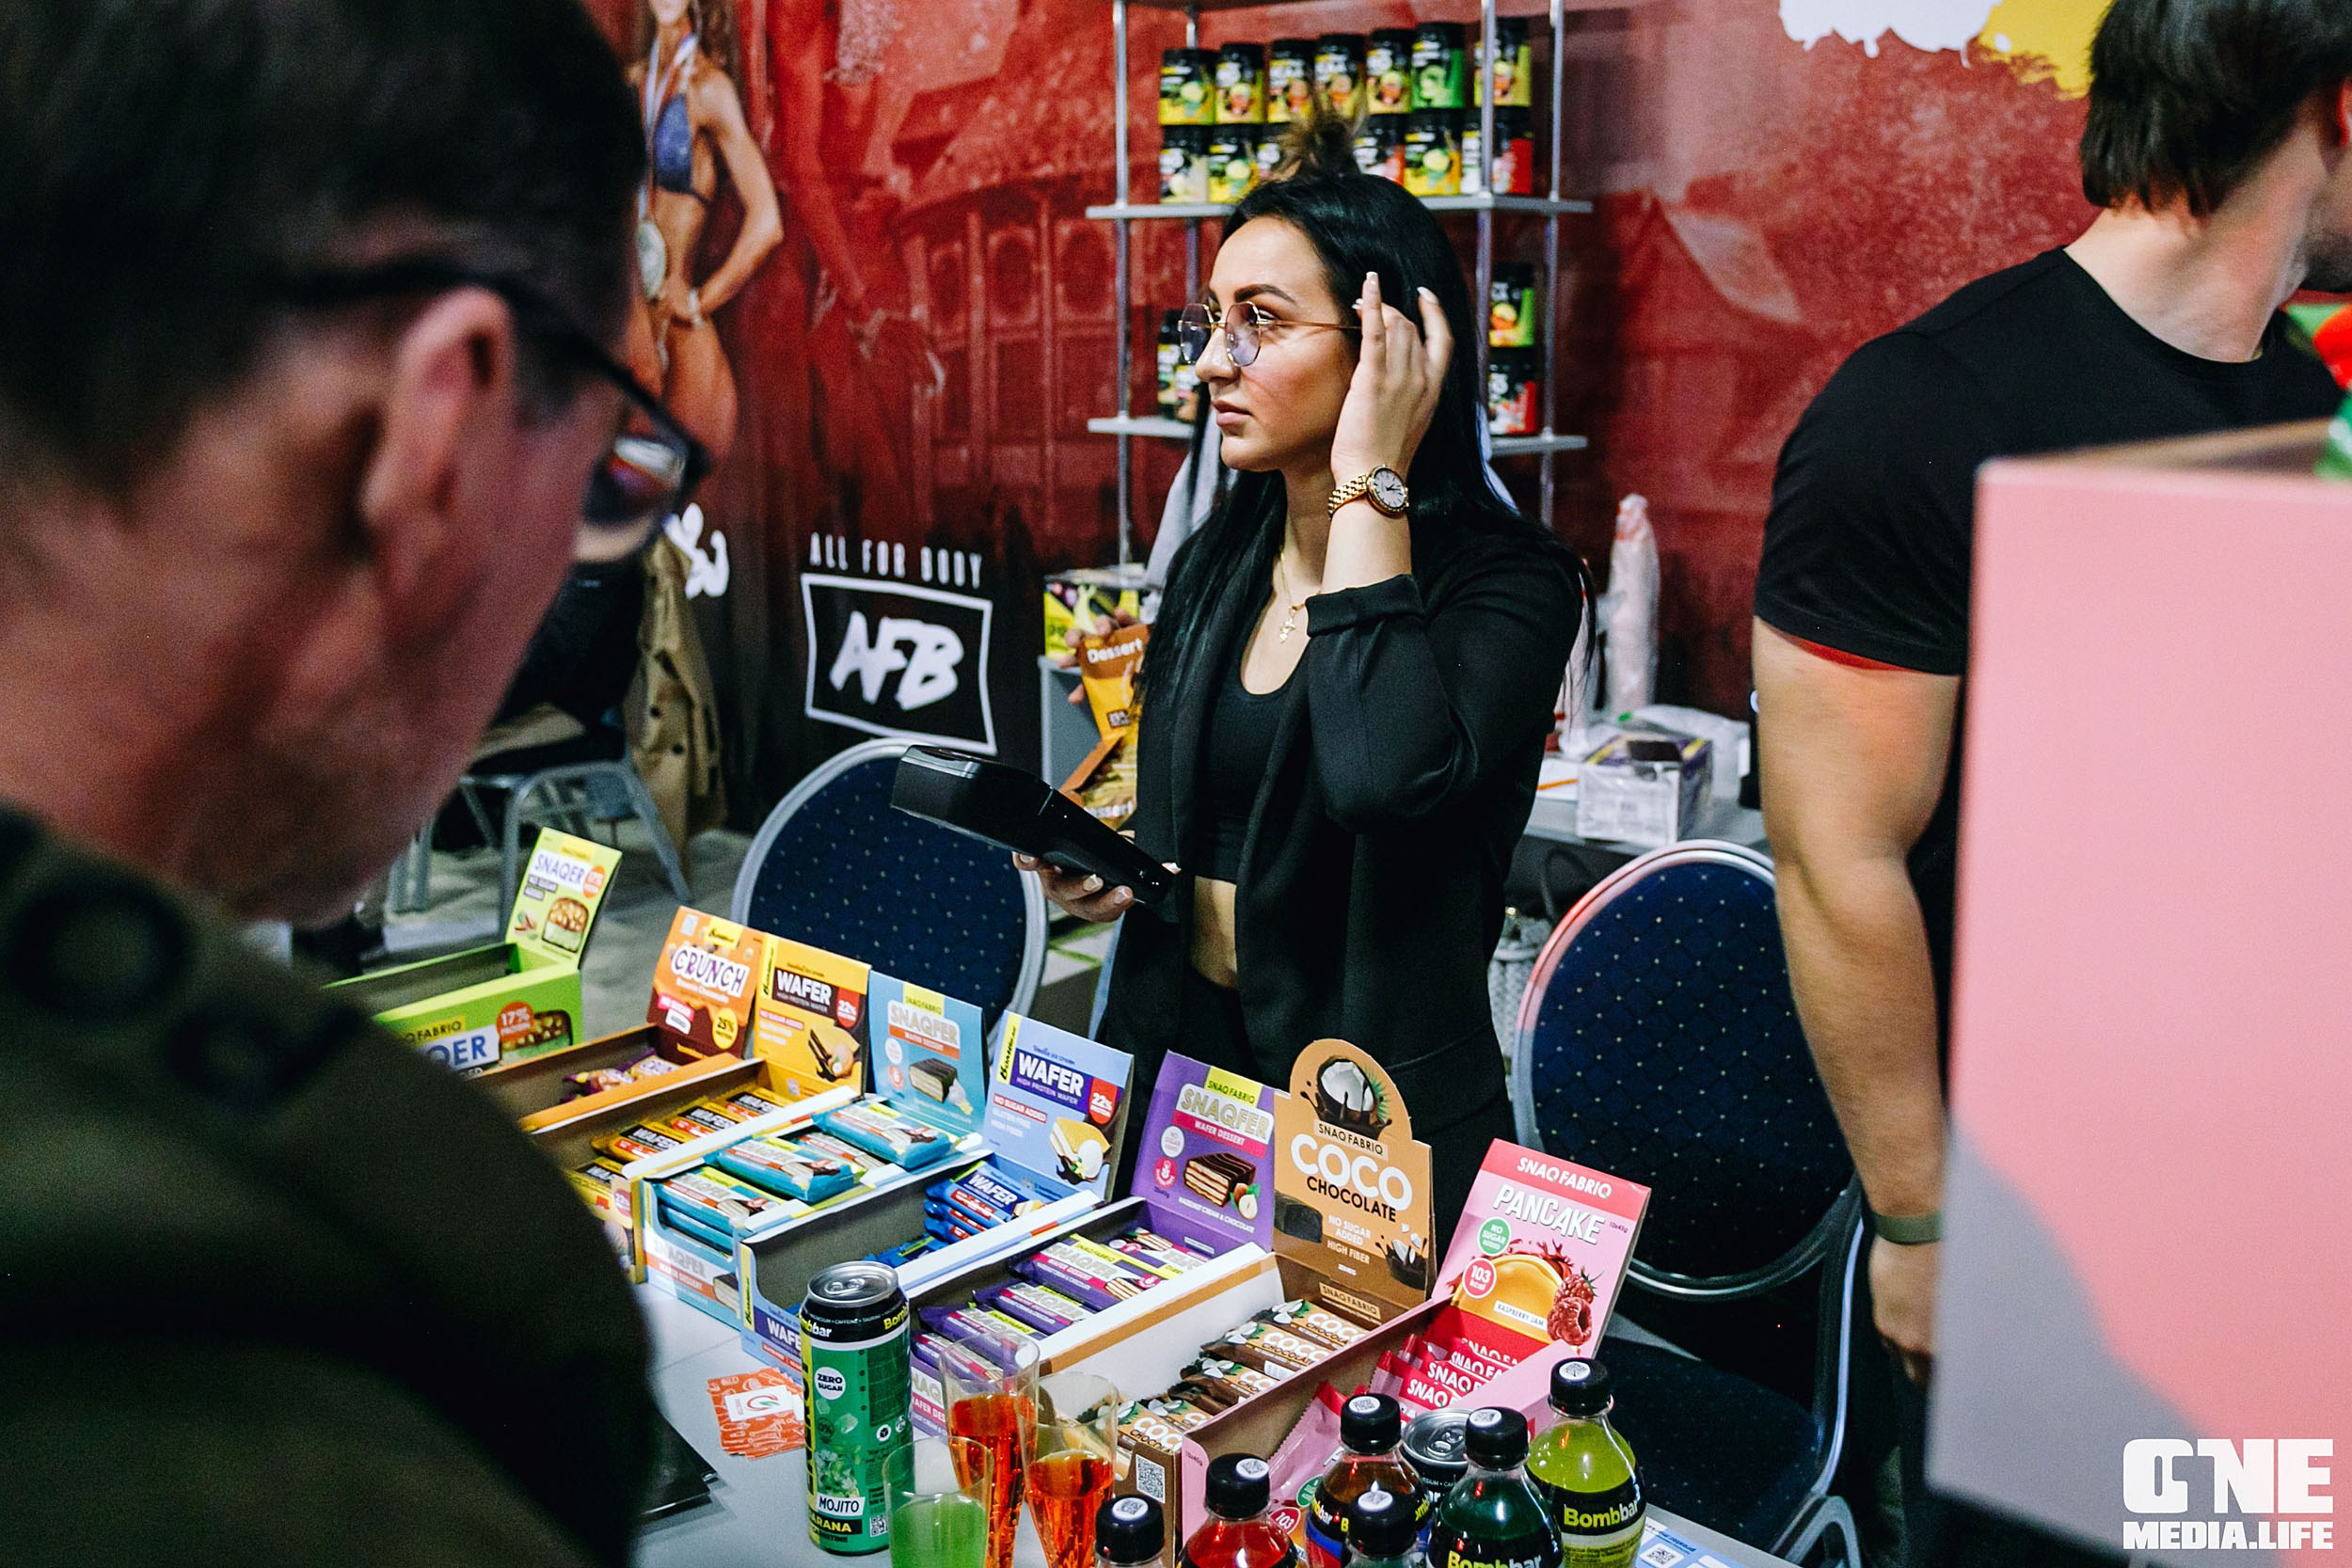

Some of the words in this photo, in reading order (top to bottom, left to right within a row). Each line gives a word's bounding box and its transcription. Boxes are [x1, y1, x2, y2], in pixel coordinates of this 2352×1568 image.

[809, 531, 849, 571] ALL
[862, 539, 906, 578] FOR
[920, 546, 982, 589] BODY
[829, 610, 964, 711] AFB
[1087, 638, 1142, 664] Dessert
[535, 854, 585, 885] SNAQER
[675, 949, 746, 994] CRUNCH
[776, 969, 833, 1006] WAFER
[890, 1004, 959, 1046] SNAQFER
[1018, 1052, 1085, 1098] WAFER
[1207, 1080, 1230, 1096] SNAQ
[1016, 1076, 1031, 1088] HIGH
[1031, 1081, 1057, 1098] PROTEIN
[1057, 1089, 1078, 1106] WAFER
[1091, 1092, 1113, 1110] 22%
[993, 1094, 1004, 1105] NO
[1004, 1098, 1025, 1113] SUGAR
[1025, 1104, 1047, 1122] ADDED
[1181, 1088, 1270, 1141] SNAQFER
[1194, 1120, 1217, 1135] WAFER
[1217, 1128, 1246, 1146] DESSERT
[1318, 1123, 1347, 1142] SNAQ
[1347, 1133, 1384, 1156] FABRIQ
[1290, 1132, 1413, 1212] COCO
[1517, 1157, 1560, 1182] SNAQ
[1558, 1169, 1612, 1200] FABRIQ
[967, 1173, 1019, 1206] WAFER
[1306, 1175, 1397, 1223] CHOCOLATE
[1327, 1214, 1343, 1228] NO
[1343, 1220, 1372, 1240] SUGAR
[1492, 1183, 1607, 1246] PANCAKE
[1335, 1228, 1364, 1246] ADDED
[1482, 1229, 1506, 1244] SUGAR
[1490, 1224, 1503, 1234] NO
[1045, 1243, 1120, 1282] SNAQFER
[1327, 1240, 1348, 1257] HIGH
[1348, 1248, 1370, 1265] FIBER
[1470, 1264, 1490, 1284] 103
[1470, 1278, 1487, 1292] kcal
[1322, 1285, 1346, 1304] SNAQ
[802, 1318, 832, 1338] bbar
[1497, 1305, 1530, 1323] RASPBERRY
[1530, 1315, 1545, 1327] JAM
[766, 1317, 803, 1351] WAFE
[1461, 1338, 1502, 1360] NAQ
[1427, 1362, 1471, 1393] SNAQ
[1451, 1351, 1485, 1376] SNAQ
[817, 1373, 843, 1385] ZERO
[818, 1383, 843, 1392] SUGAR
[1406, 1378, 1449, 1407] SNAQ
[1133, 1417, 1183, 1452] COC
[818, 1496, 860, 1513] MOJITO
[1563, 1498, 1639, 1528] Bombbar
[1274, 1512, 1294, 1530] 103
